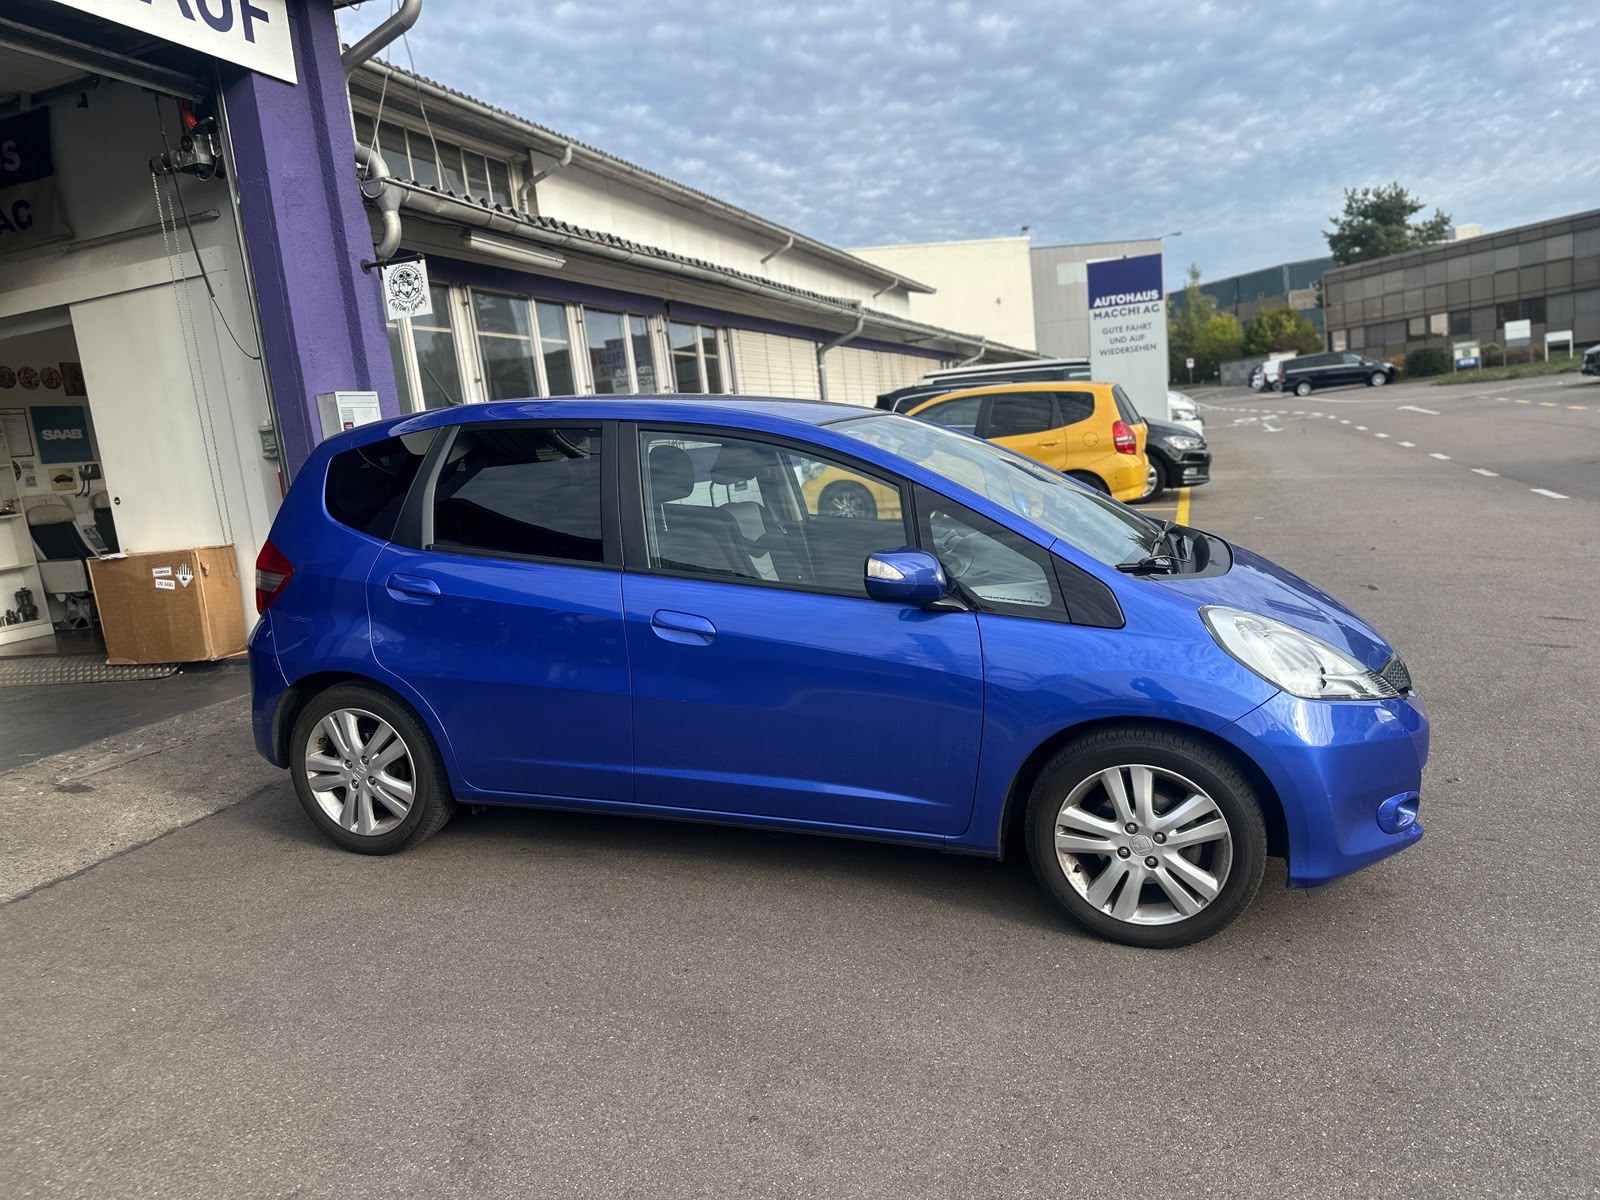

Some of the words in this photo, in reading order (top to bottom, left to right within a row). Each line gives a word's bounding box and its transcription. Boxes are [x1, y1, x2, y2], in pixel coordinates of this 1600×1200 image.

[1093, 289, 1159, 308] AUTOHAUS
[1093, 306, 1140, 320] MACCHI
[1143, 304, 1160, 314] AG
[1102, 326, 1123, 335] GUTE
[1125, 322, 1152, 332] FAHRT
[1109, 336, 1127, 344] UND
[1129, 334, 1145, 343] AUF
[1099, 343, 1157, 356] WIEDERSEHEN
[41, 429, 83, 441] SAAB
